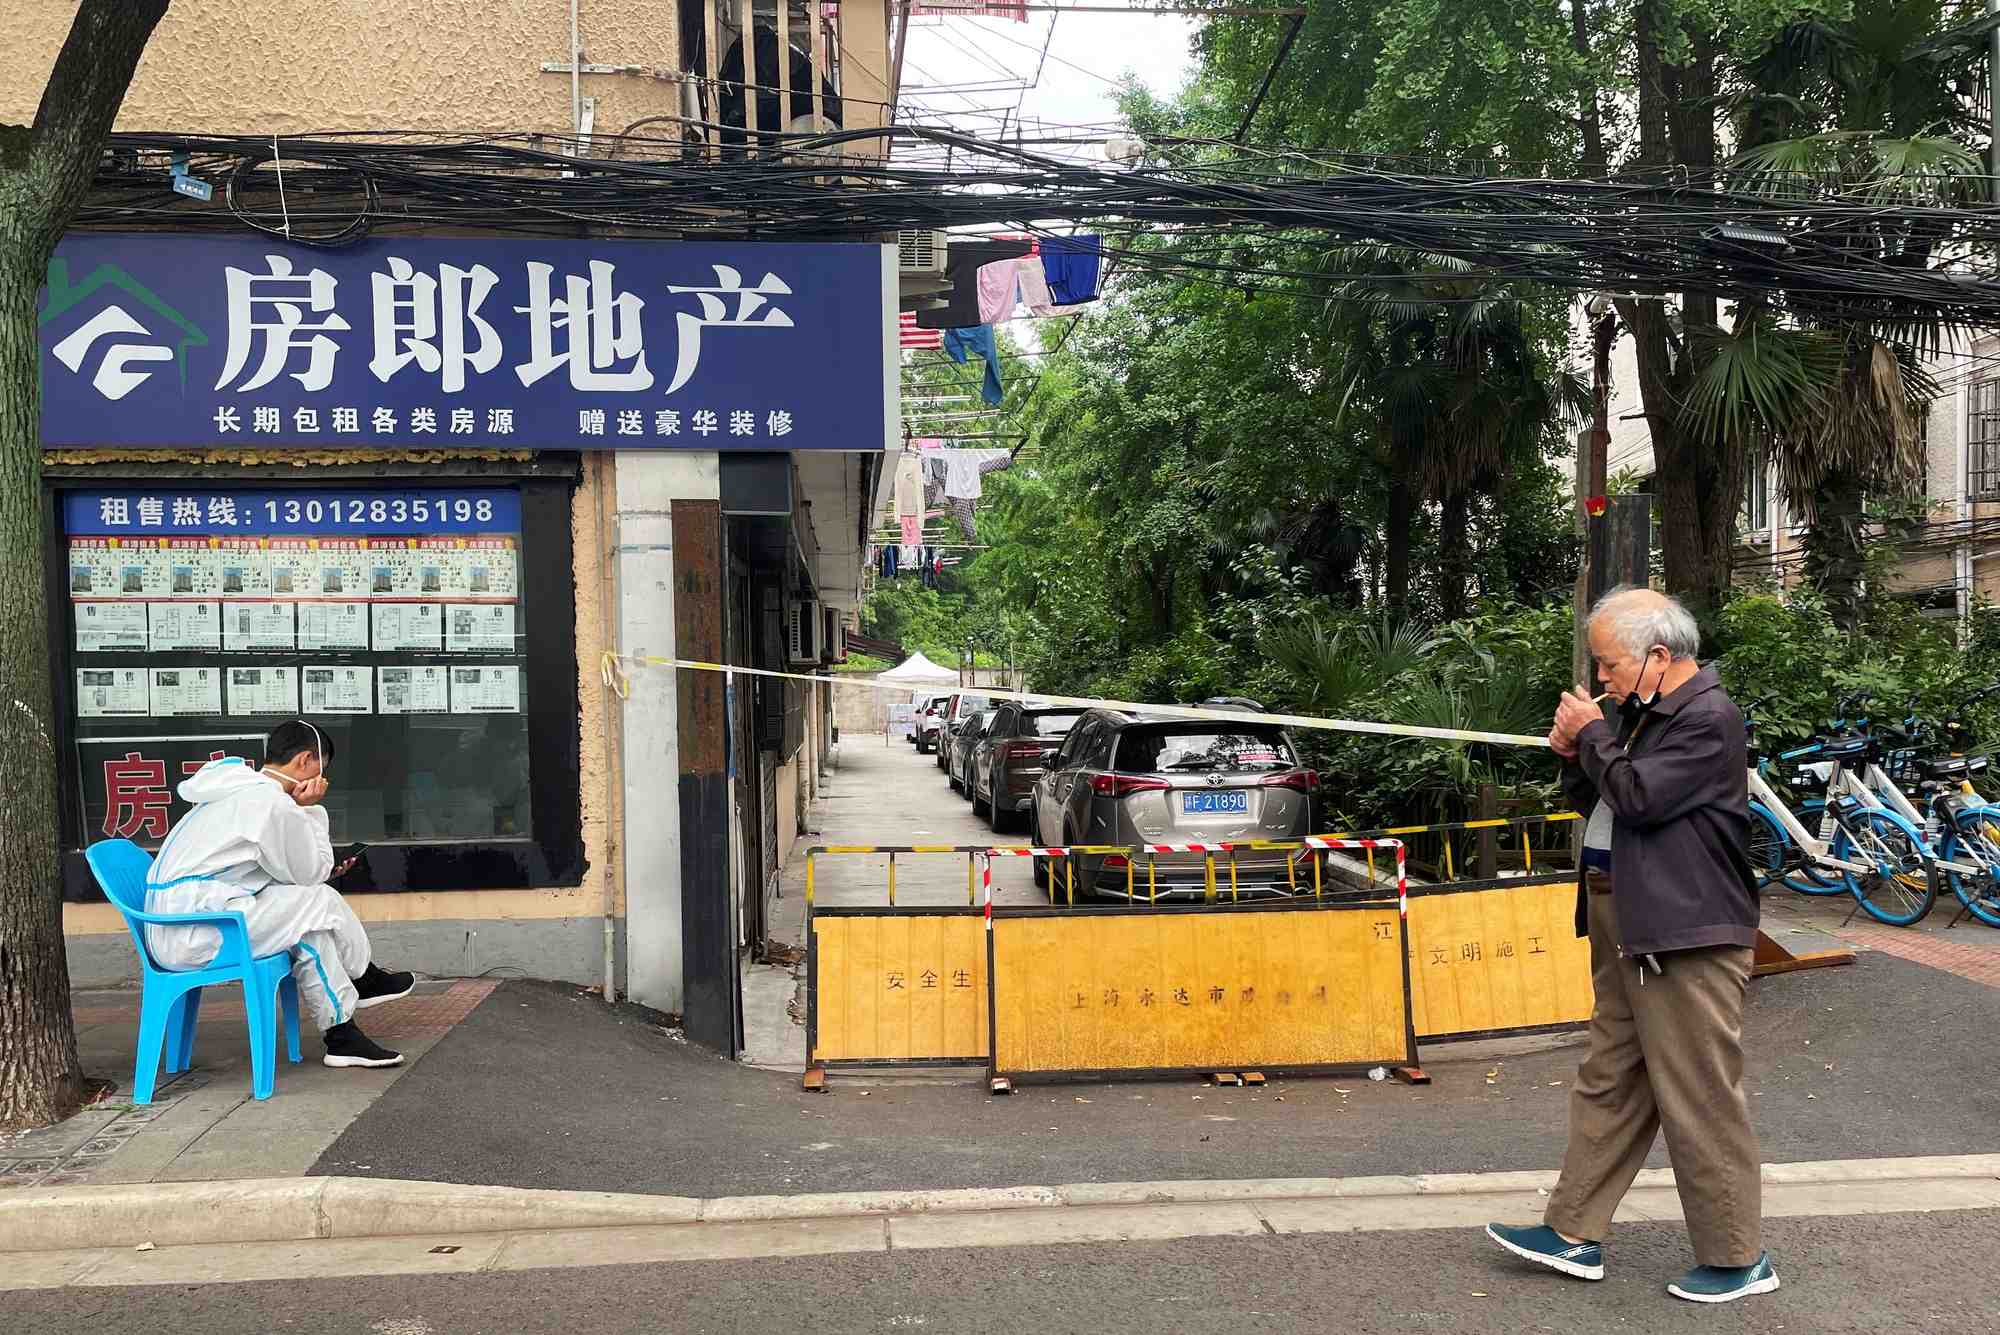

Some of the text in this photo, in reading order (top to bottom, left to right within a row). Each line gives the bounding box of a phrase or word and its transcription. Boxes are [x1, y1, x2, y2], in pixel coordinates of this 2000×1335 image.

[213, 254, 795, 395] 房郎地产
[212, 406, 794, 437] 长期包租各类房源 赠送豪华装修
[102, 751, 255, 840] 房
[1408, 936, 1546, 965] 文明施工
[887, 969, 971, 989] 安全生
